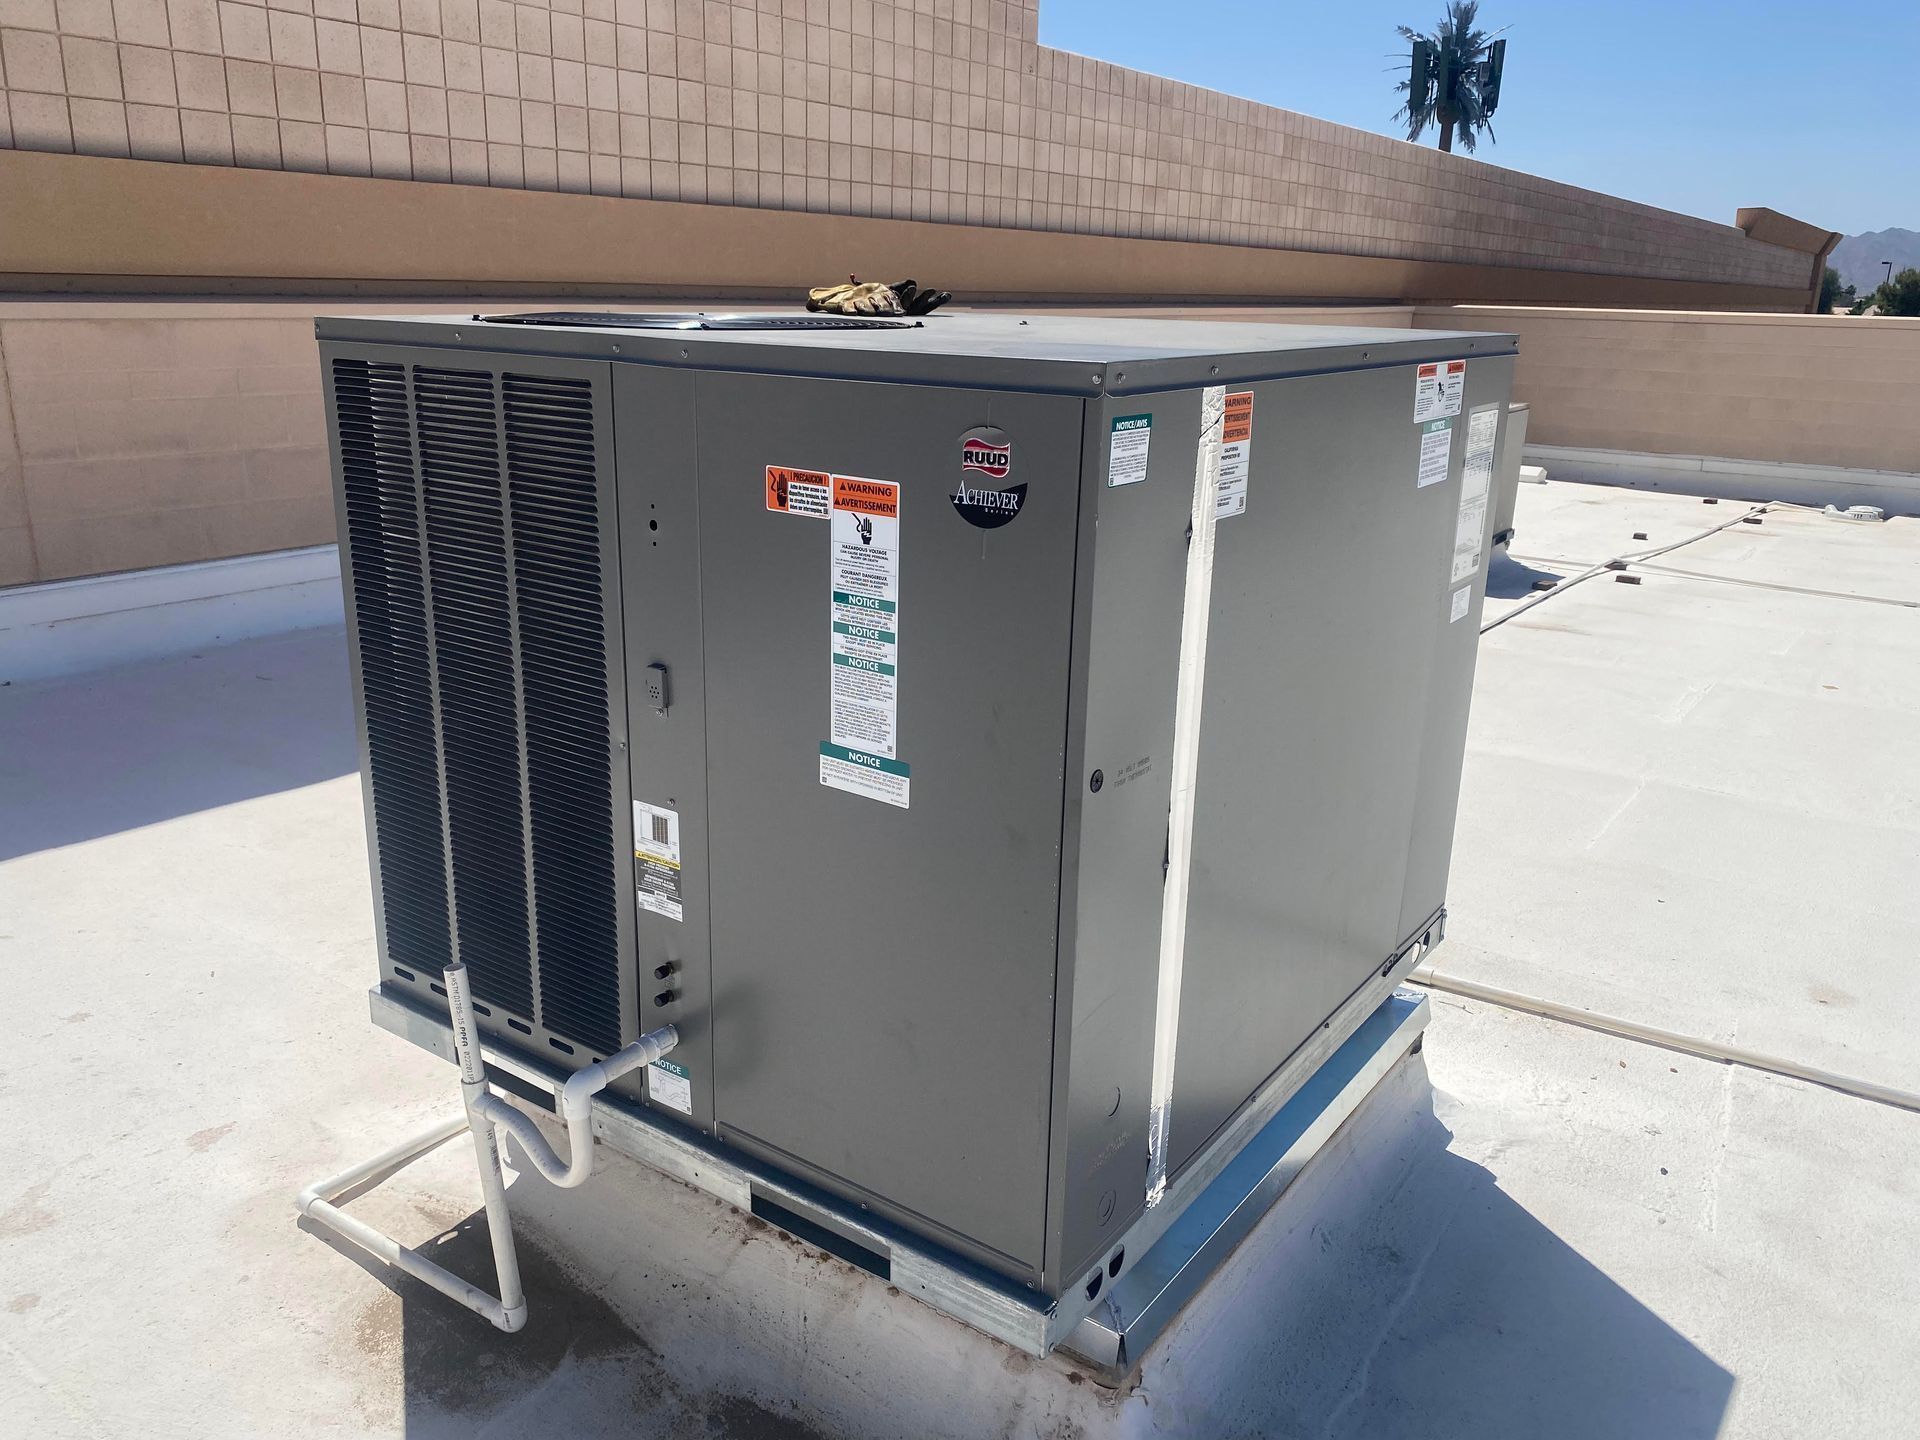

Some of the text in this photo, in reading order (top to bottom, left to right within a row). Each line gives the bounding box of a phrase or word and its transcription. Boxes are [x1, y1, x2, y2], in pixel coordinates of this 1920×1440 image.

[1116, 419, 1148, 430] NOTICE/AVIS
[964, 450, 1008, 466] RUUD
[848, 483, 892, 496] WARNING
[841, 498, 896, 513] AVERTISSEMENT
[842, 544, 867, 552] HAZARDOUS
[849, 595, 879, 608] NOTICE
[849, 626, 879, 639] NOTICE
[849, 658, 878, 671] NOTICE
[848, 752, 881, 767] NOTICE
[451, 978, 459, 994] ASTM
[460, 1027, 468, 1046] PPFA
[656, 1060, 681, 1074] NOTICE
